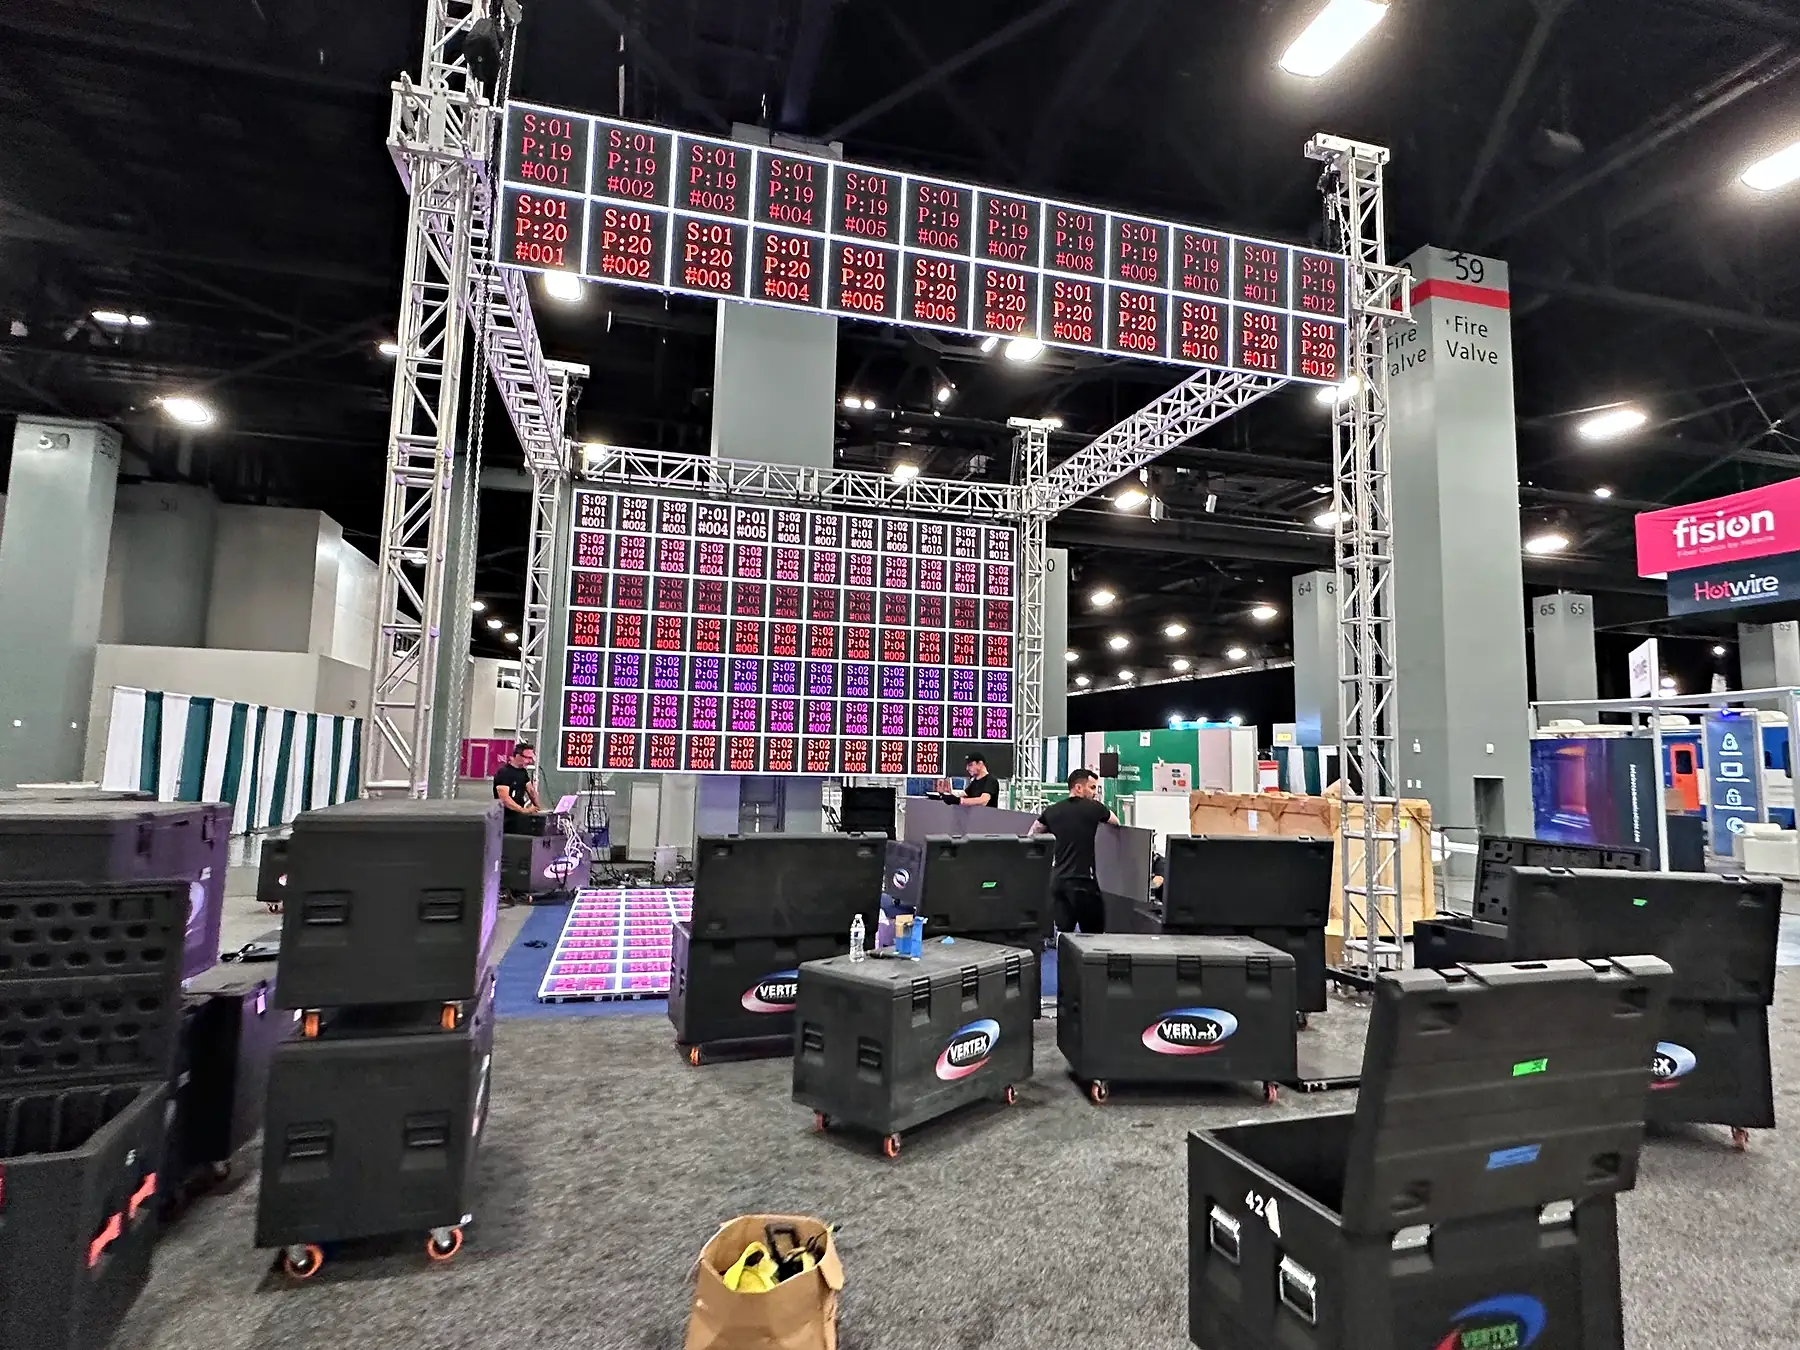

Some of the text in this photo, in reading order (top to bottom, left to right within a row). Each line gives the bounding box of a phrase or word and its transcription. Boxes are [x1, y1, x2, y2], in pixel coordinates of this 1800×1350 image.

[524, 114, 570, 139] S:01
[522, 136, 572, 161] P:19
[610, 129, 654, 154] S:01
[608, 151, 656, 175] P:19
[692, 145, 734, 168] S:01
[521, 161, 567, 184] #001
[690, 166, 736, 189] P:19
[771, 159, 812, 182] S:01
[607, 176, 654, 198] #002
[769, 180, 814, 203] P:19
[846, 173, 886, 195] S:01
[518, 194, 566, 219] S:01
[689, 190, 735, 211] #003
[845, 193, 888, 215] P:19
[919, 186, 958, 208] S:01
[769, 203, 812, 225] #004
[918, 206, 959, 228] P:19
[989, 199, 1026, 220] S:01
[516, 217, 567, 242] P:20
[605, 208, 650, 232] S:01
[845, 216, 887, 237] #005
[989, 219, 1028, 240] P:19
[1057, 211, 1092, 232] S:01
[602, 230, 651, 255] P:20
[687, 222, 731, 245] S:01
[918, 228, 958, 248] #006
[1056, 230, 1094, 251] P:19
[1121, 223, 1156, 243] S:01
[516, 242, 564, 266] #001
[766, 234, 809, 258] S:01
[988, 240, 1027, 260] #007
[1121, 242, 1157, 262] P:19
[1184, 234, 1217, 254] S:01
[685, 243, 732, 267] P:20
[843, 247, 884, 269] S:01
[1056, 252, 1093, 271] #008
[1184, 253, 1219, 273] P:19
[1244, 245, 1276, 265] S:01
[602, 254, 650, 277] #002
[765, 256, 810, 279] P:20
[916, 258, 956, 281] S:01
[1121, 263, 1157, 282] #009
[1244, 264, 1278, 283] P:19
[1302, 256, 1333, 275] S:01
[1455, 256, 1484, 283] 59
[685, 266, 731, 289] #003
[841, 267, 885, 290] P:20
[986, 270, 1025, 291] S:01
[1183, 274, 1219, 292] #010
[1302, 274, 1335, 293] P:19
[765, 278, 809, 301] #004
[914, 279, 956, 301] P:20
[1054, 281, 1091, 302] S:01
[1244, 283, 1276, 302] #011
[841, 290, 884, 311] #005
[985, 290, 1026, 311] P:20
[1120, 291, 1155, 312] S:01
[1302, 294, 1335, 312] #012
[914, 301, 955, 322] #006
[1053, 300, 1092, 322] P:20
[1118, 311, 1156, 331] P:20
[1182, 301, 1217, 322] S:01
[1243, 311, 1276, 331] S:01
[985, 312, 1025, 333] #007
[1053, 321, 1091, 342] #008
[1181, 320, 1218, 341] P:20
[1301, 321, 1334, 340] S:01
[1454, 315, 1488, 338] Fire
[1119, 331, 1156, 351] #009
[1242, 330, 1278, 349] P:20
[1301, 339, 1335, 358] P:20
[1182, 340, 1218, 360] #010
[1243, 350, 1276, 369] #011
[1446, 340, 1498, 365] Valve
[1302, 358, 1336, 378] #012
[1387, 347, 1427, 377] alve
[582, 494, 607, 506] S:02
[581, 504, 605, 517] P:01
[698, 506, 728, 521] P:01
[736, 509, 765, 524] P:01
[815, 514, 837, 526] S:02
[580, 532, 605, 545] S:02
[814, 524, 836, 536] P:01
[921, 523, 942, 534] S:02
[1672, 510, 1775, 548] fision
[921, 533, 941, 545] P:01
[578, 543, 604, 556] P:02
[954, 571, 975, 583] P:02
[955, 562, 976, 573] S:02
[1298, 580, 1312, 596] 64
[1326, 581, 1338, 595] 6
[1694, 574, 1779, 601] Hotwire
[1540, 602, 1556, 616] 65
[1570, 602, 1585, 615] 65
[616, 614, 641, 625] S:02
[616, 625, 640, 636] P:04
[811, 625, 834, 636] S:02
[919, 631, 940, 642] S:02
[811, 635, 833, 647] P:04
[919, 641, 940, 652] P:04
[573, 651, 598, 663] S:02
[772, 661, 795, 672] S:02
[572, 662, 598, 674] P:05
[772, 672, 795, 682] P:05
[883, 666, 904, 677] S:02
[987, 671, 1007, 681] S:02
[882, 676, 904, 687] P:05
[986, 681, 1007, 692] P:05
[612, 693, 637, 704] S:02
[611, 704, 636, 716] P:06
[917, 704, 939, 715] S:02
[917, 715, 939, 726] P:06
[691, 735, 715, 747] S:02
[807, 739, 830, 750] S:02
[916, 741, 938, 752] S:02
[691, 746, 715, 758] P:07
[807, 749, 830, 760] P:07
[916, 752, 938, 763] P:07
[759, 983, 798, 997] VERTE
[950, 1034, 988, 1060] VERTEX
